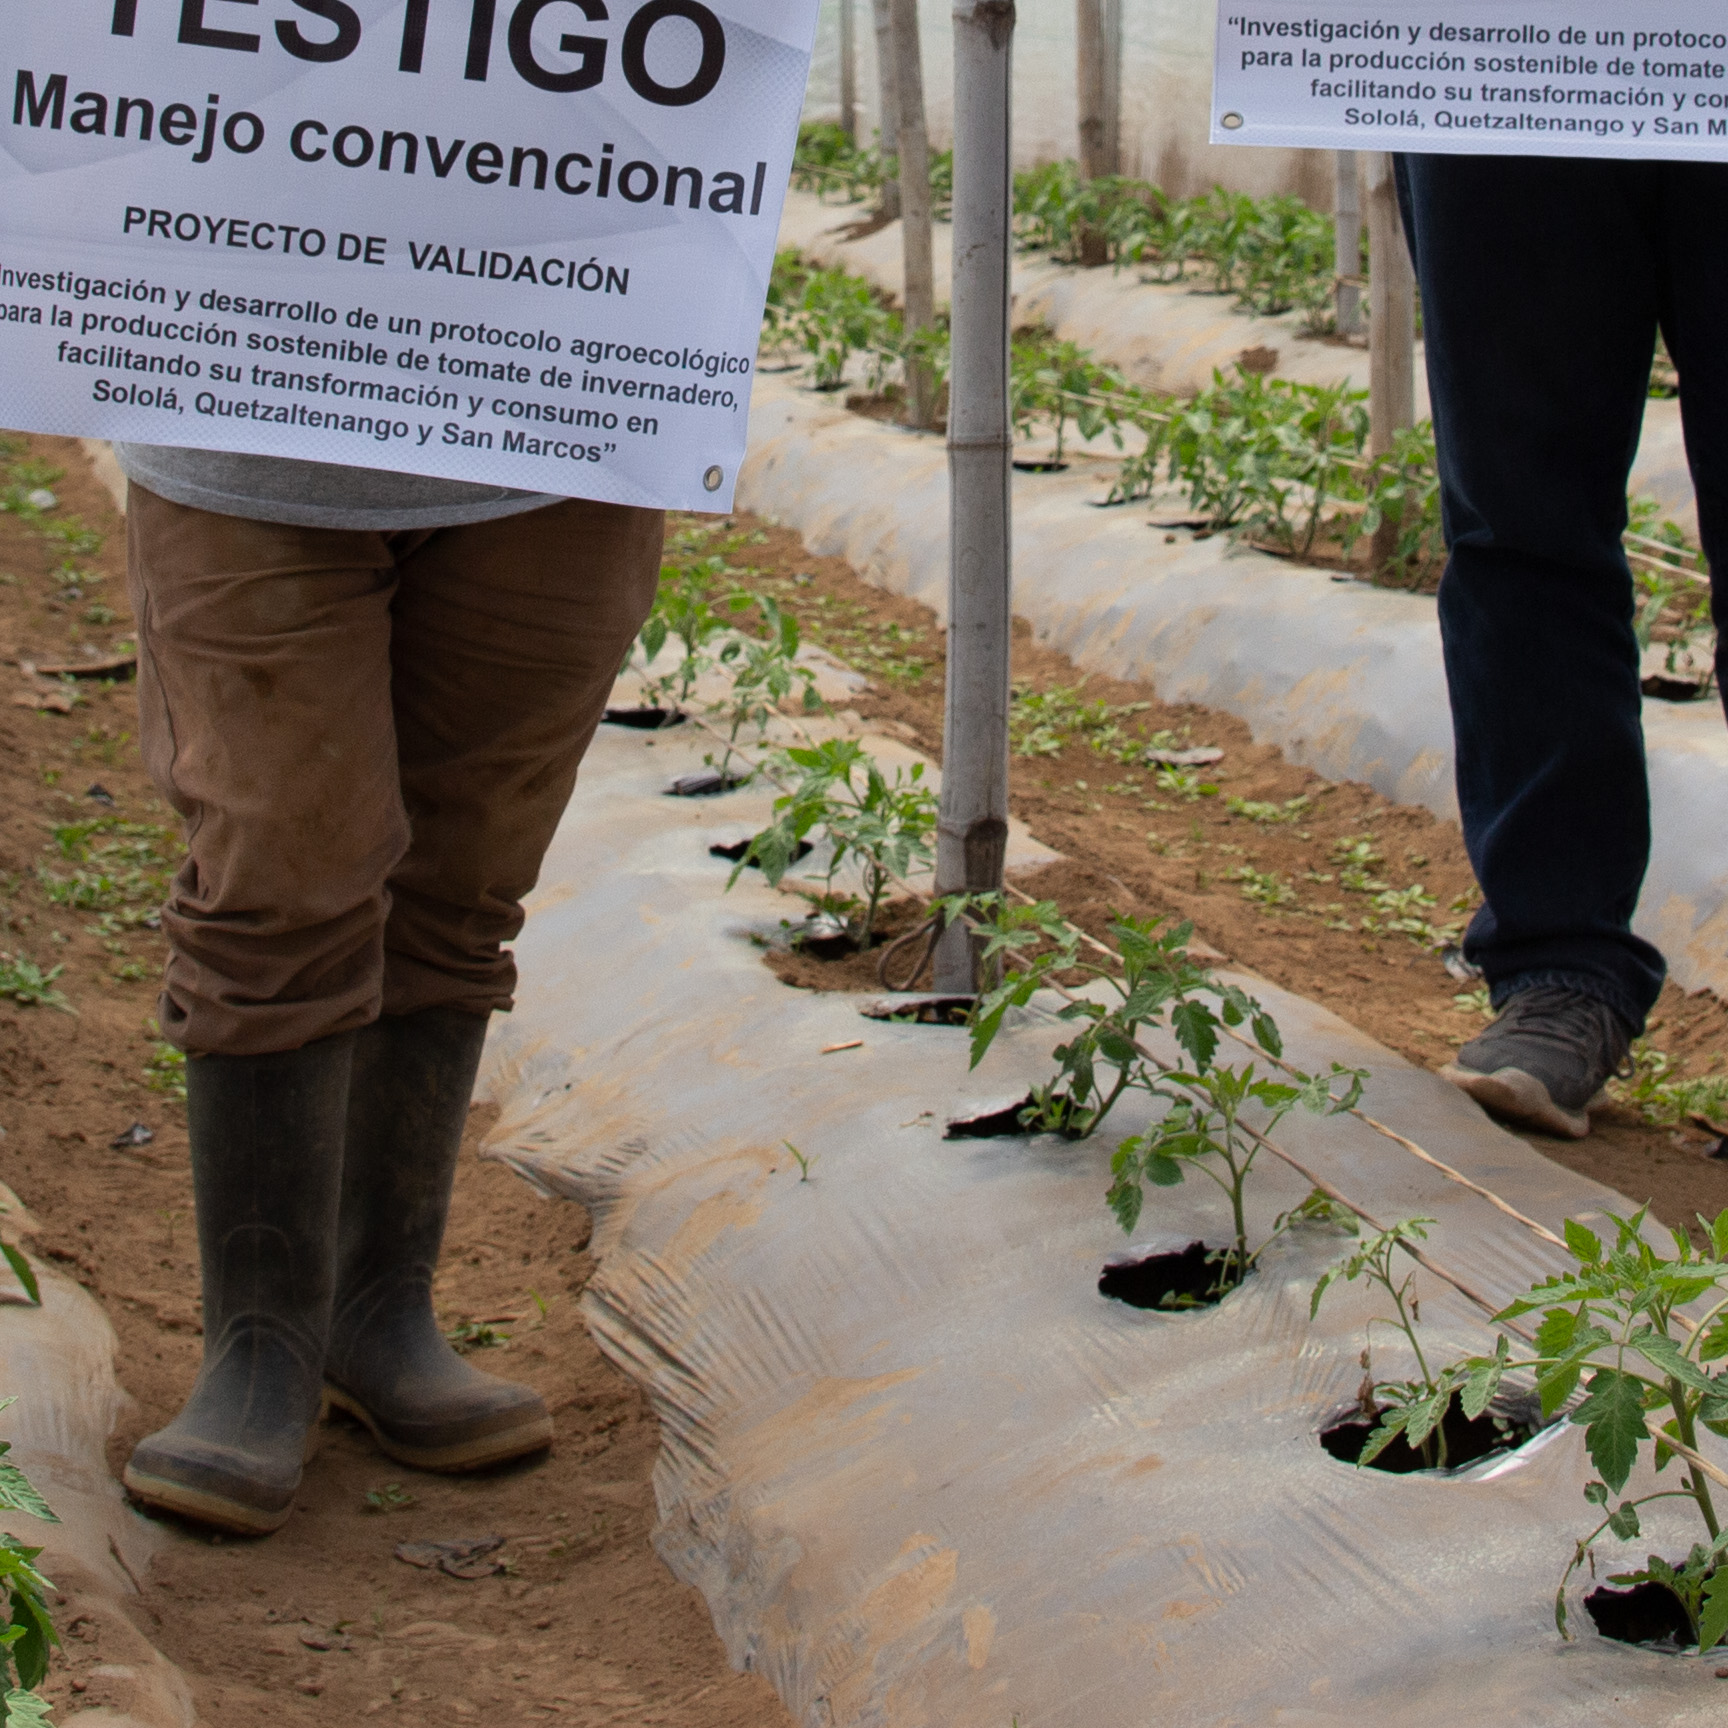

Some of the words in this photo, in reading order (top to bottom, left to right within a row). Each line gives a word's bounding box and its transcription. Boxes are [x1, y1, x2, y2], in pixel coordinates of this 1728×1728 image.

[1241, 51, 1293, 71] para
[1302, 48, 1321, 68] la
[1330, 51, 1465, 74] producción
[1474, 55, 1598, 75] sostenible
[1606, 57, 1635, 76] de
[1642, 59, 1726, 79] tomate
[1408, 26, 1421, 46] y
[1429, 22, 1550, 45] desarrollo
[1558, 26, 1586, 46] de
[1596, 30, 1625, 47] un
[1311, 79, 1437, 101] facilitando
[1444, 85, 1473, 102] su
[1480, 84, 1663, 107] transformación
[1673, 93, 1687, 113] y
[1344, 107, 1425, 131] Sololá,
[1433, 110, 1624, 136] Quetzaltenango
[1631, 120, 1646, 139] y
[1653, 116, 1699, 137] San
[13, 70, 265, 163] Manejo
[290, 120, 767, 216] convencional
[124, 206, 326, 257] PROYECTO
[337, 233, 388, 266] DE
[408, 241, 630, 295] VALIDACIÓN
[51, 304, 73, 328] la
[81, 313, 238, 348] producción
[247, 332, 388, 366] sostenible
[397, 348, 430, 372] de
[438, 353, 531, 384] tomate
[540, 366, 573, 390] de
[582, 369, 737, 413] invernadero,
[174, 290, 191, 312] y
[200, 289, 337, 325] desarrollo
[346, 306, 379, 331] de
[388, 316, 422, 337] un
[430, 322, 562, 353] protocolo
[570, 339, 750, 378] agroecológico
[58, 341, 202, 377] facilitando
[209, 364, 242, 384] su
[252, 365, 459, 410] transformación
[467, 395, 484, 419] y
[492, 399, 619, 430] consumo
[627, 416, 659, 436] en
[93, 378, 185, 416] Sololá,
[195, 392, 410, 441] Quetzaltenango
[416, 424, 433, 447] y
[442, 421, 493, 450] San
